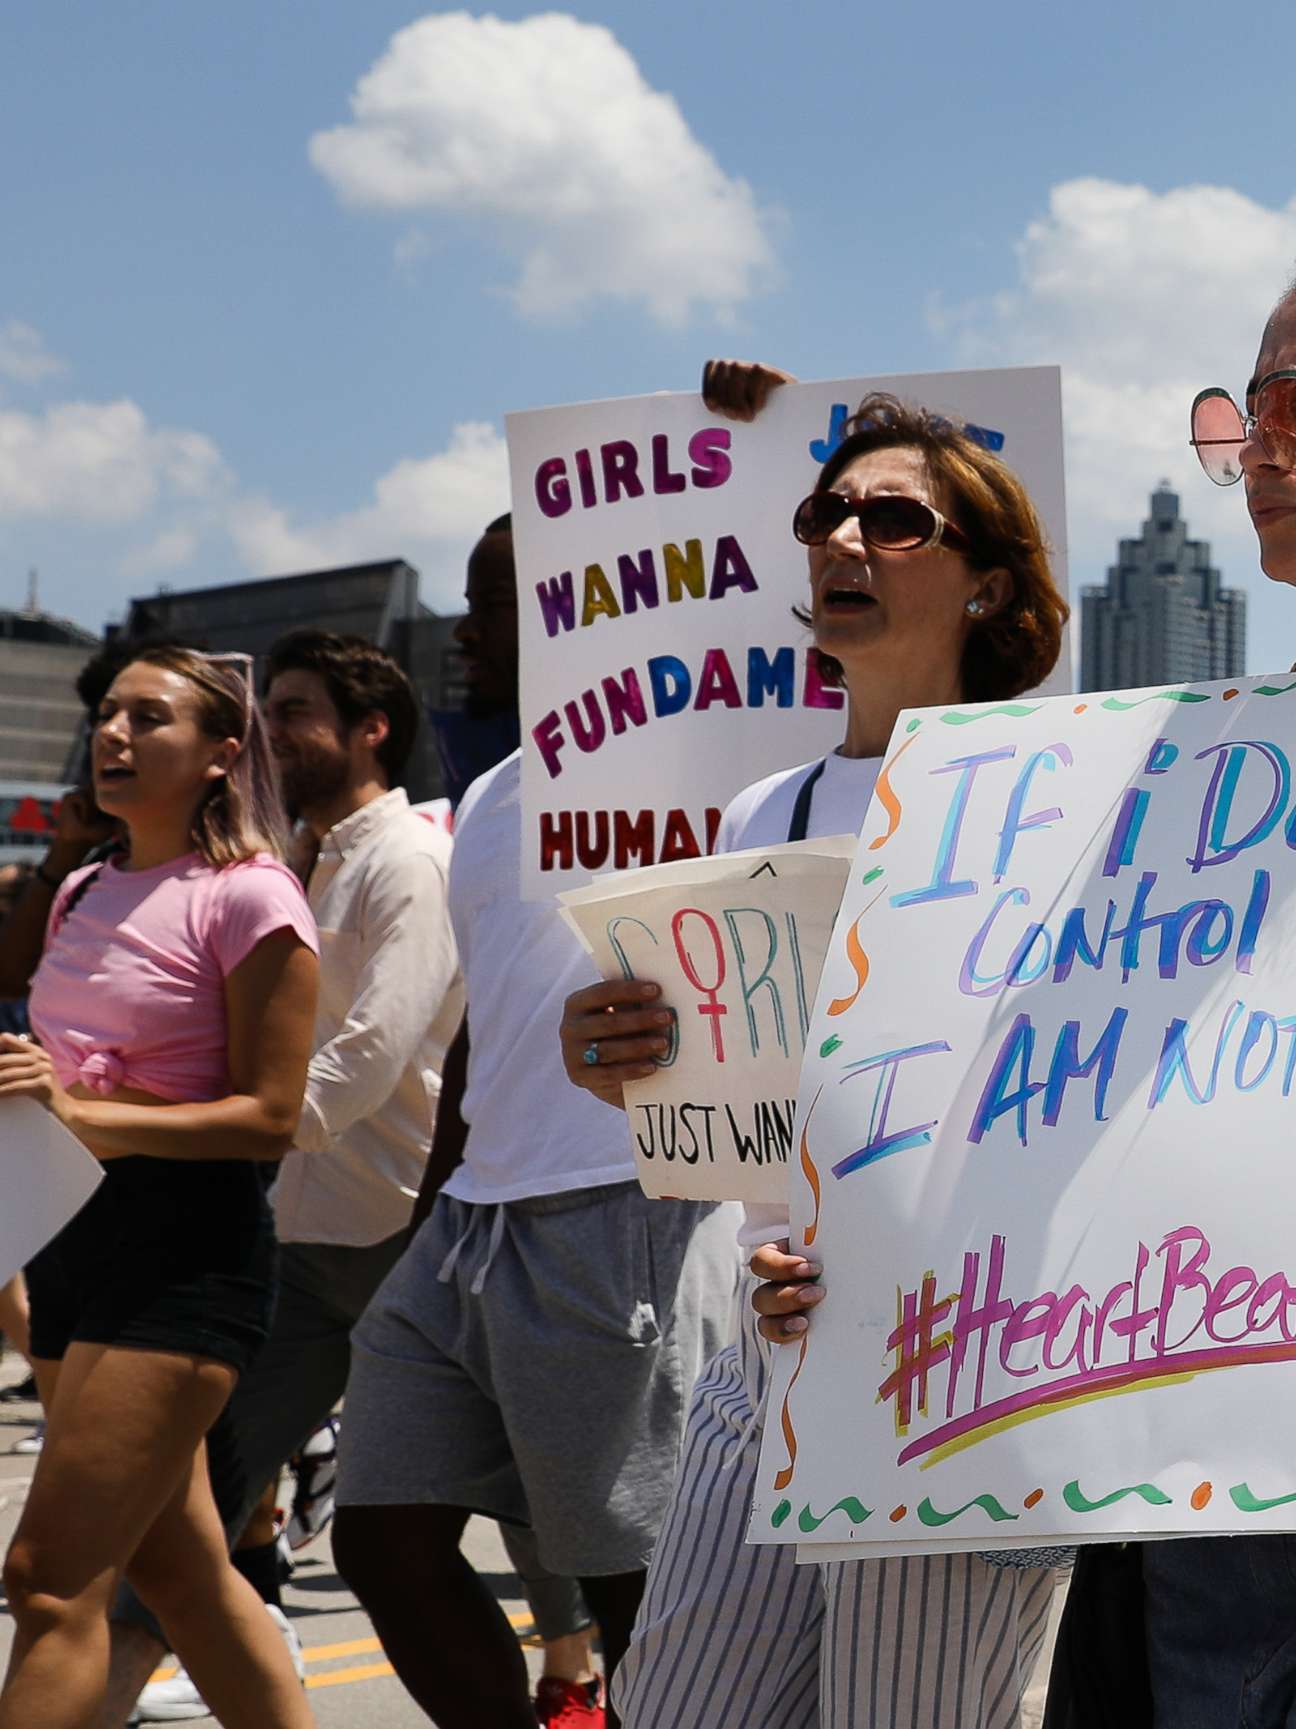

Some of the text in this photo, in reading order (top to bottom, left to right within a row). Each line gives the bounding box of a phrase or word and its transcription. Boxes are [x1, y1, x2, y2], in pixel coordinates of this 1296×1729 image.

[535, 427, 732, 518] GIRLS
[536, 535, 758, 637] WANNA
[635, 1103, 716, 1164] JUST
[725, 1099, 796, 1165] WAN
[831, 1040, 952, 1180] I
[967, 1007, 1130, 1147] AM
